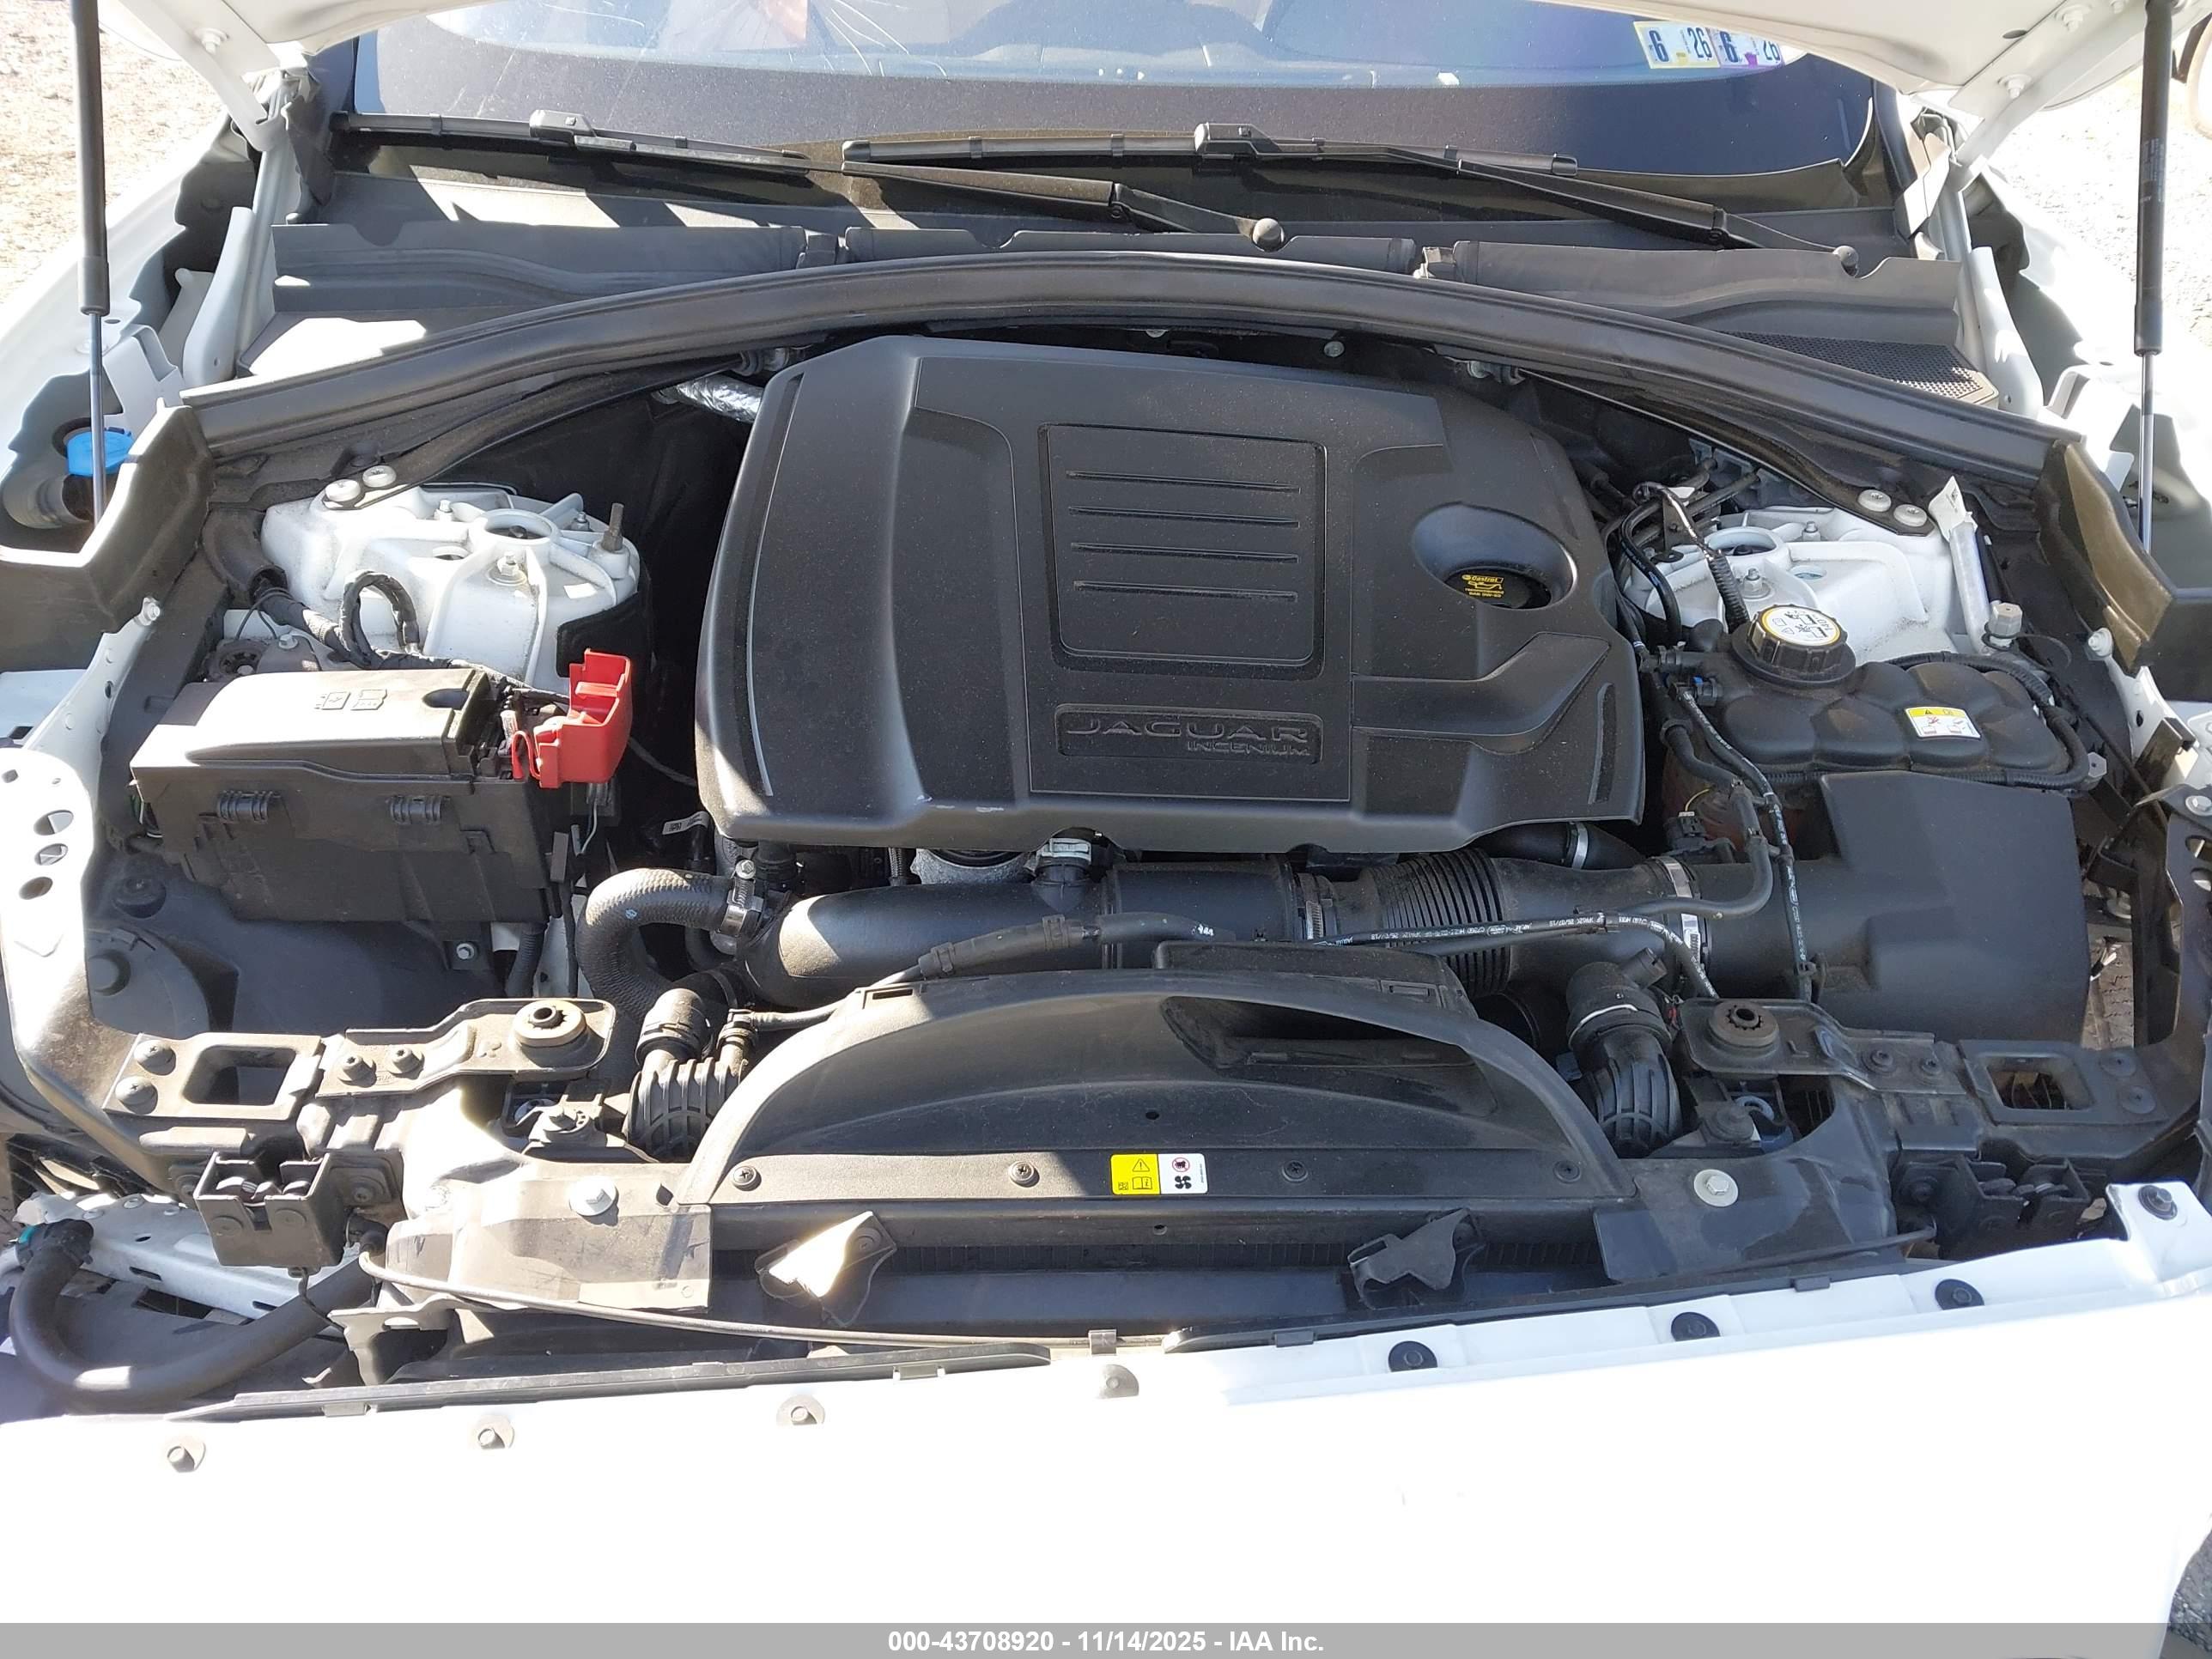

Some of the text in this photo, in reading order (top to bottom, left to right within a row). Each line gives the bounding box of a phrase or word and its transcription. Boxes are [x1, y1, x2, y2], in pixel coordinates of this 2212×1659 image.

[1649, 29, 1669, 63] 6
[1686, 27, 1712, 58] 26
[1720, 31, 1739, 63] 6
[1066, 718, 1309, 743] JAGUAR
[1187, 740, 1311, 757] INGENIUM
